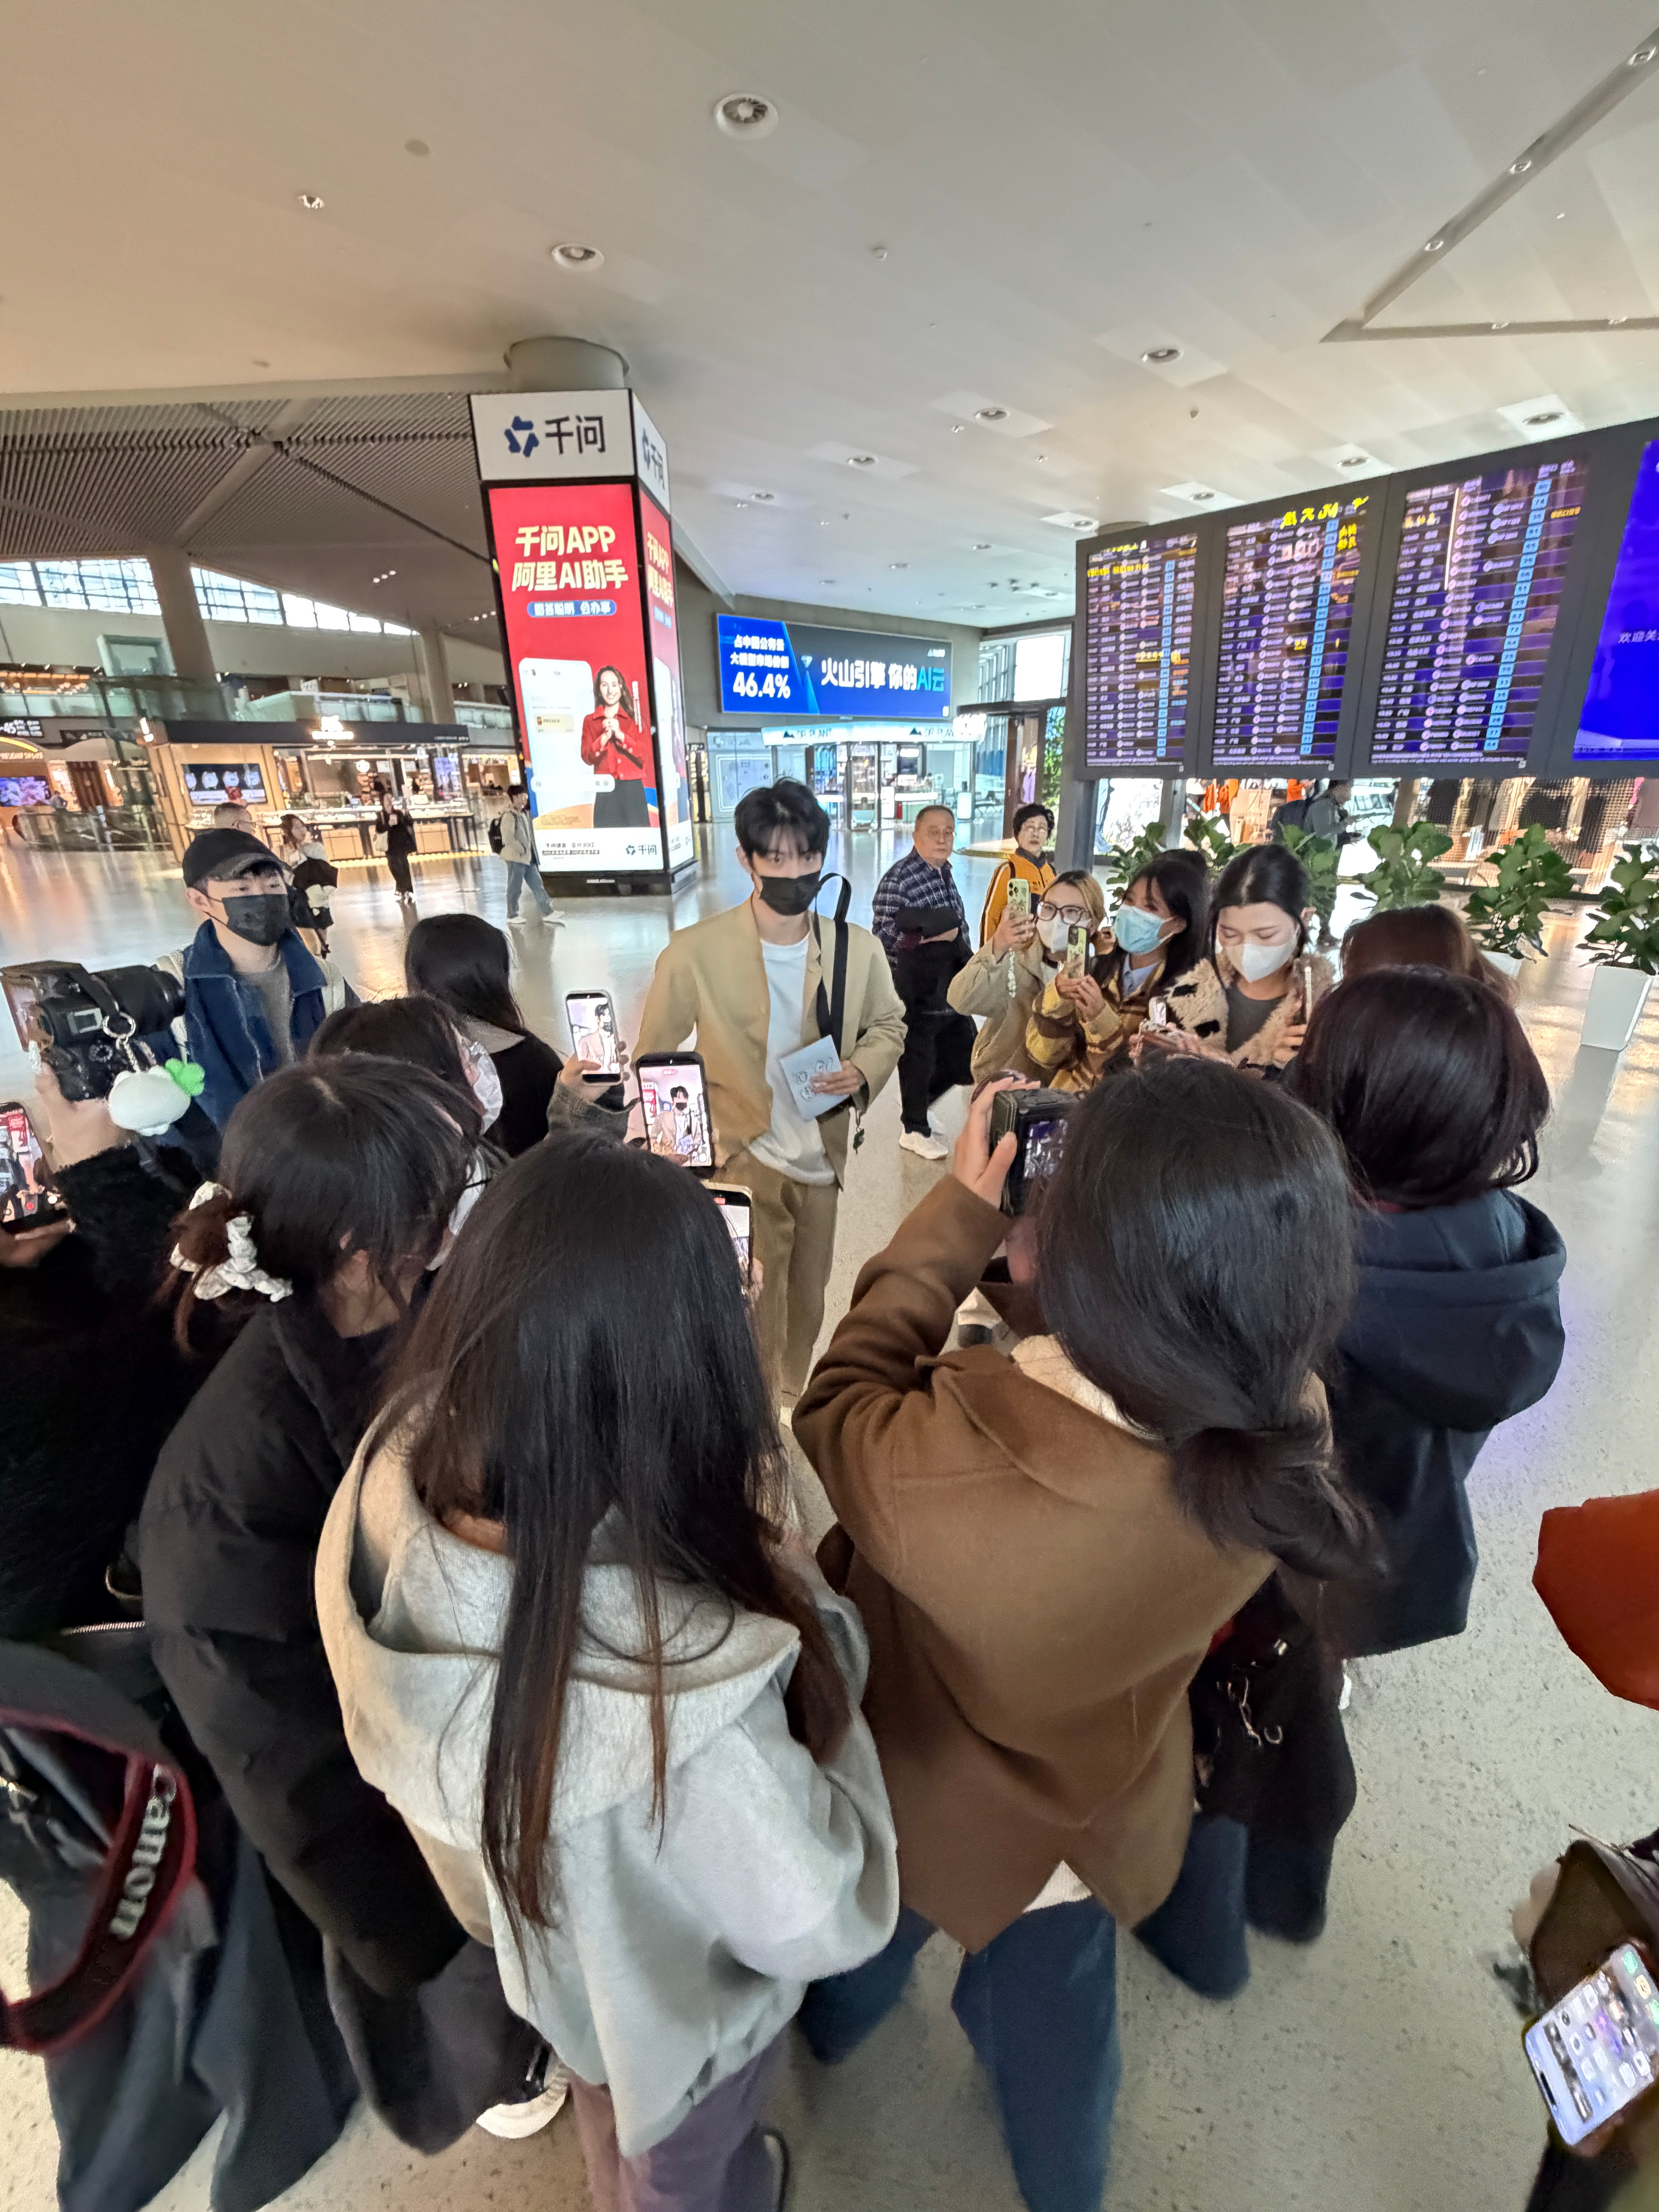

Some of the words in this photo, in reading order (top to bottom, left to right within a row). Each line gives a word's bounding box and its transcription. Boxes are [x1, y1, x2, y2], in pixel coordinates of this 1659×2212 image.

[545, 415, 606, 454] 千问
[515, 526, 616, 557] 千问APP
[512, 559, 629, 592] 阿里AI助手
[733, 672, 791, 699] 46.4%
[821, 657, 886, 689] 火山引擎
[888, 663, 945, 692] 你的AI云
[638, 844, 657, 855] 千问
